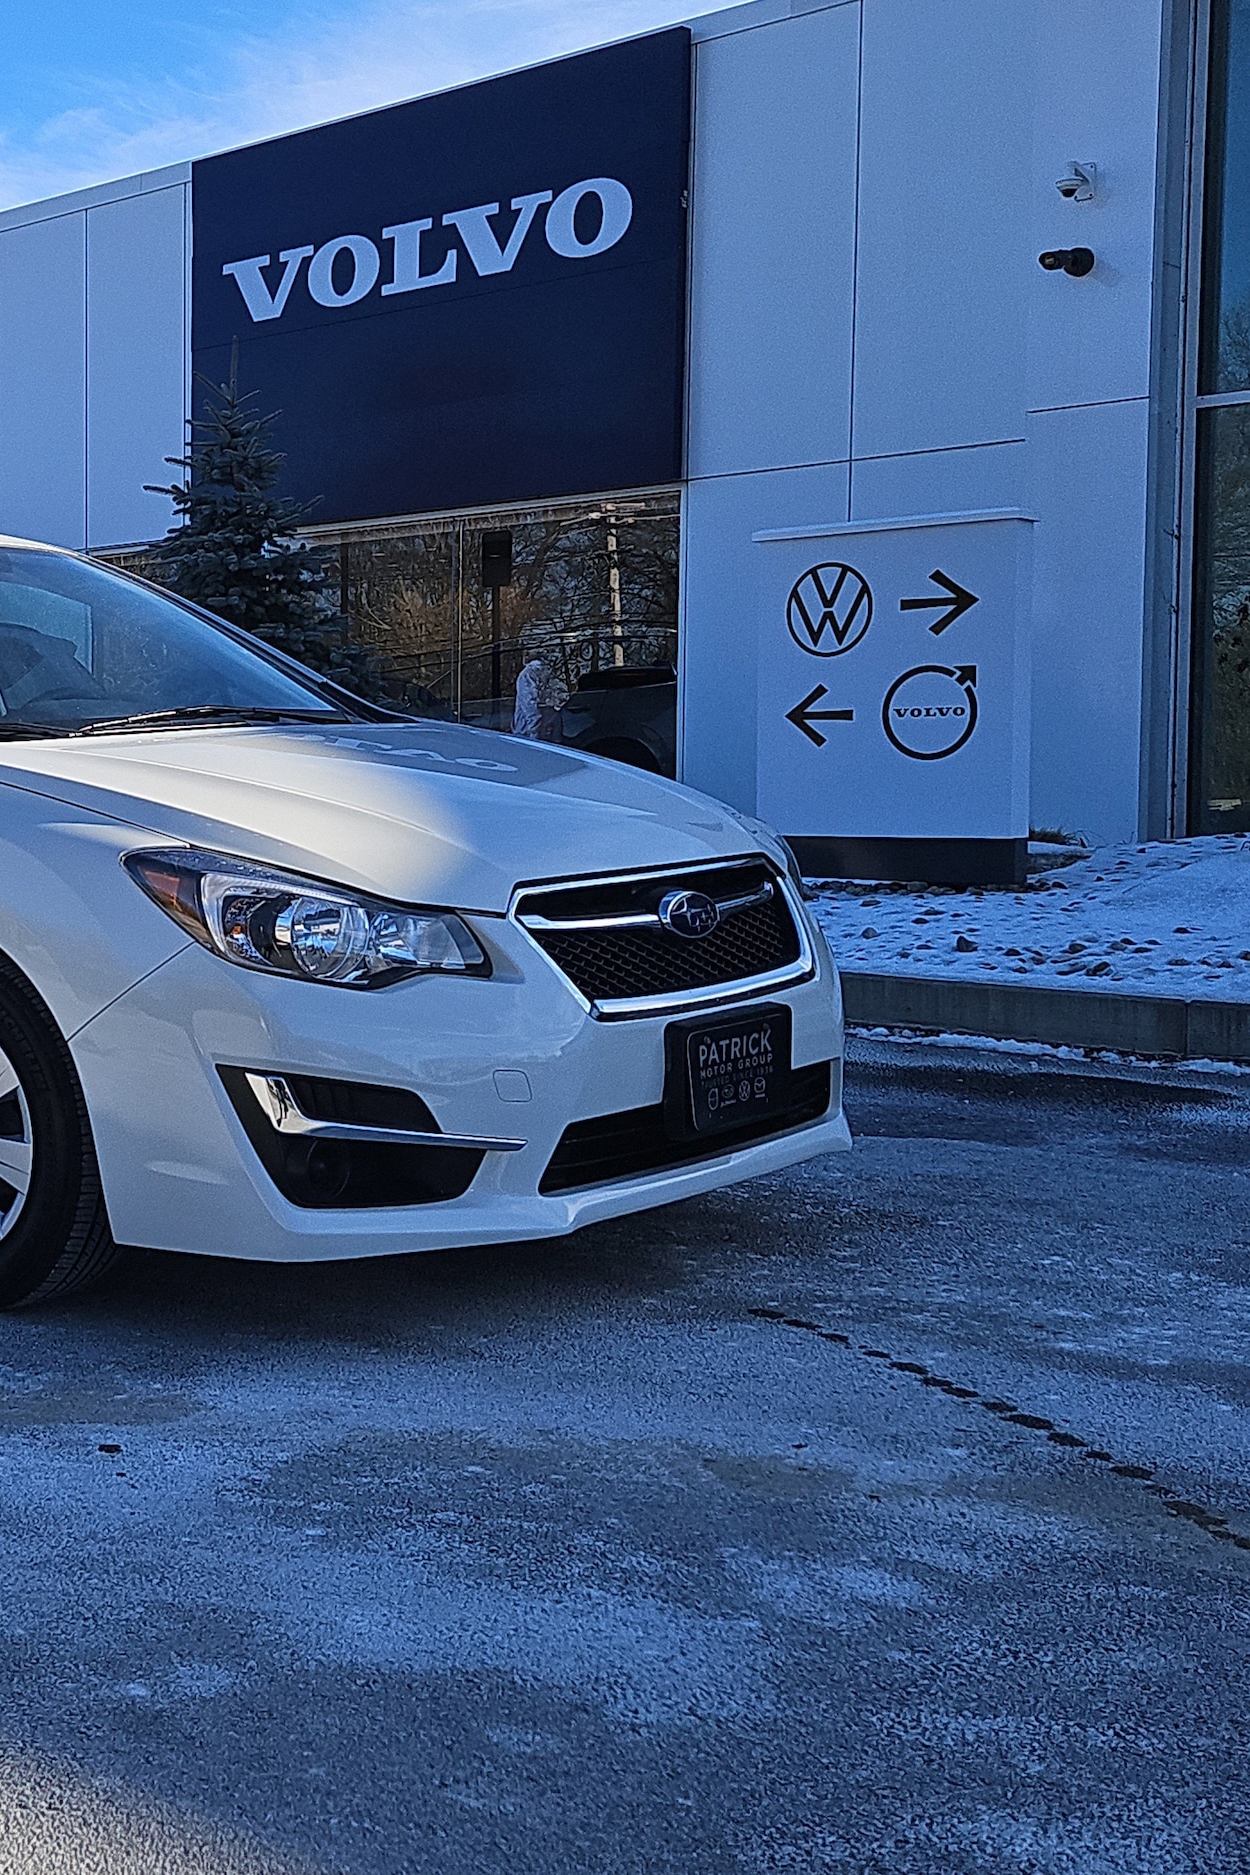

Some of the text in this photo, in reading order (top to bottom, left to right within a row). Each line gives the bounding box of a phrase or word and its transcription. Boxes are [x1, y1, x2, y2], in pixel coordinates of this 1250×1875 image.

[222, 177, 633, 322] VOLVO
[892, 706, 966, 718] VOLVO
[699, 1029, 772, 1068] PATRICK
[700, 1053, 773, 1080] MOTOR GROUP
